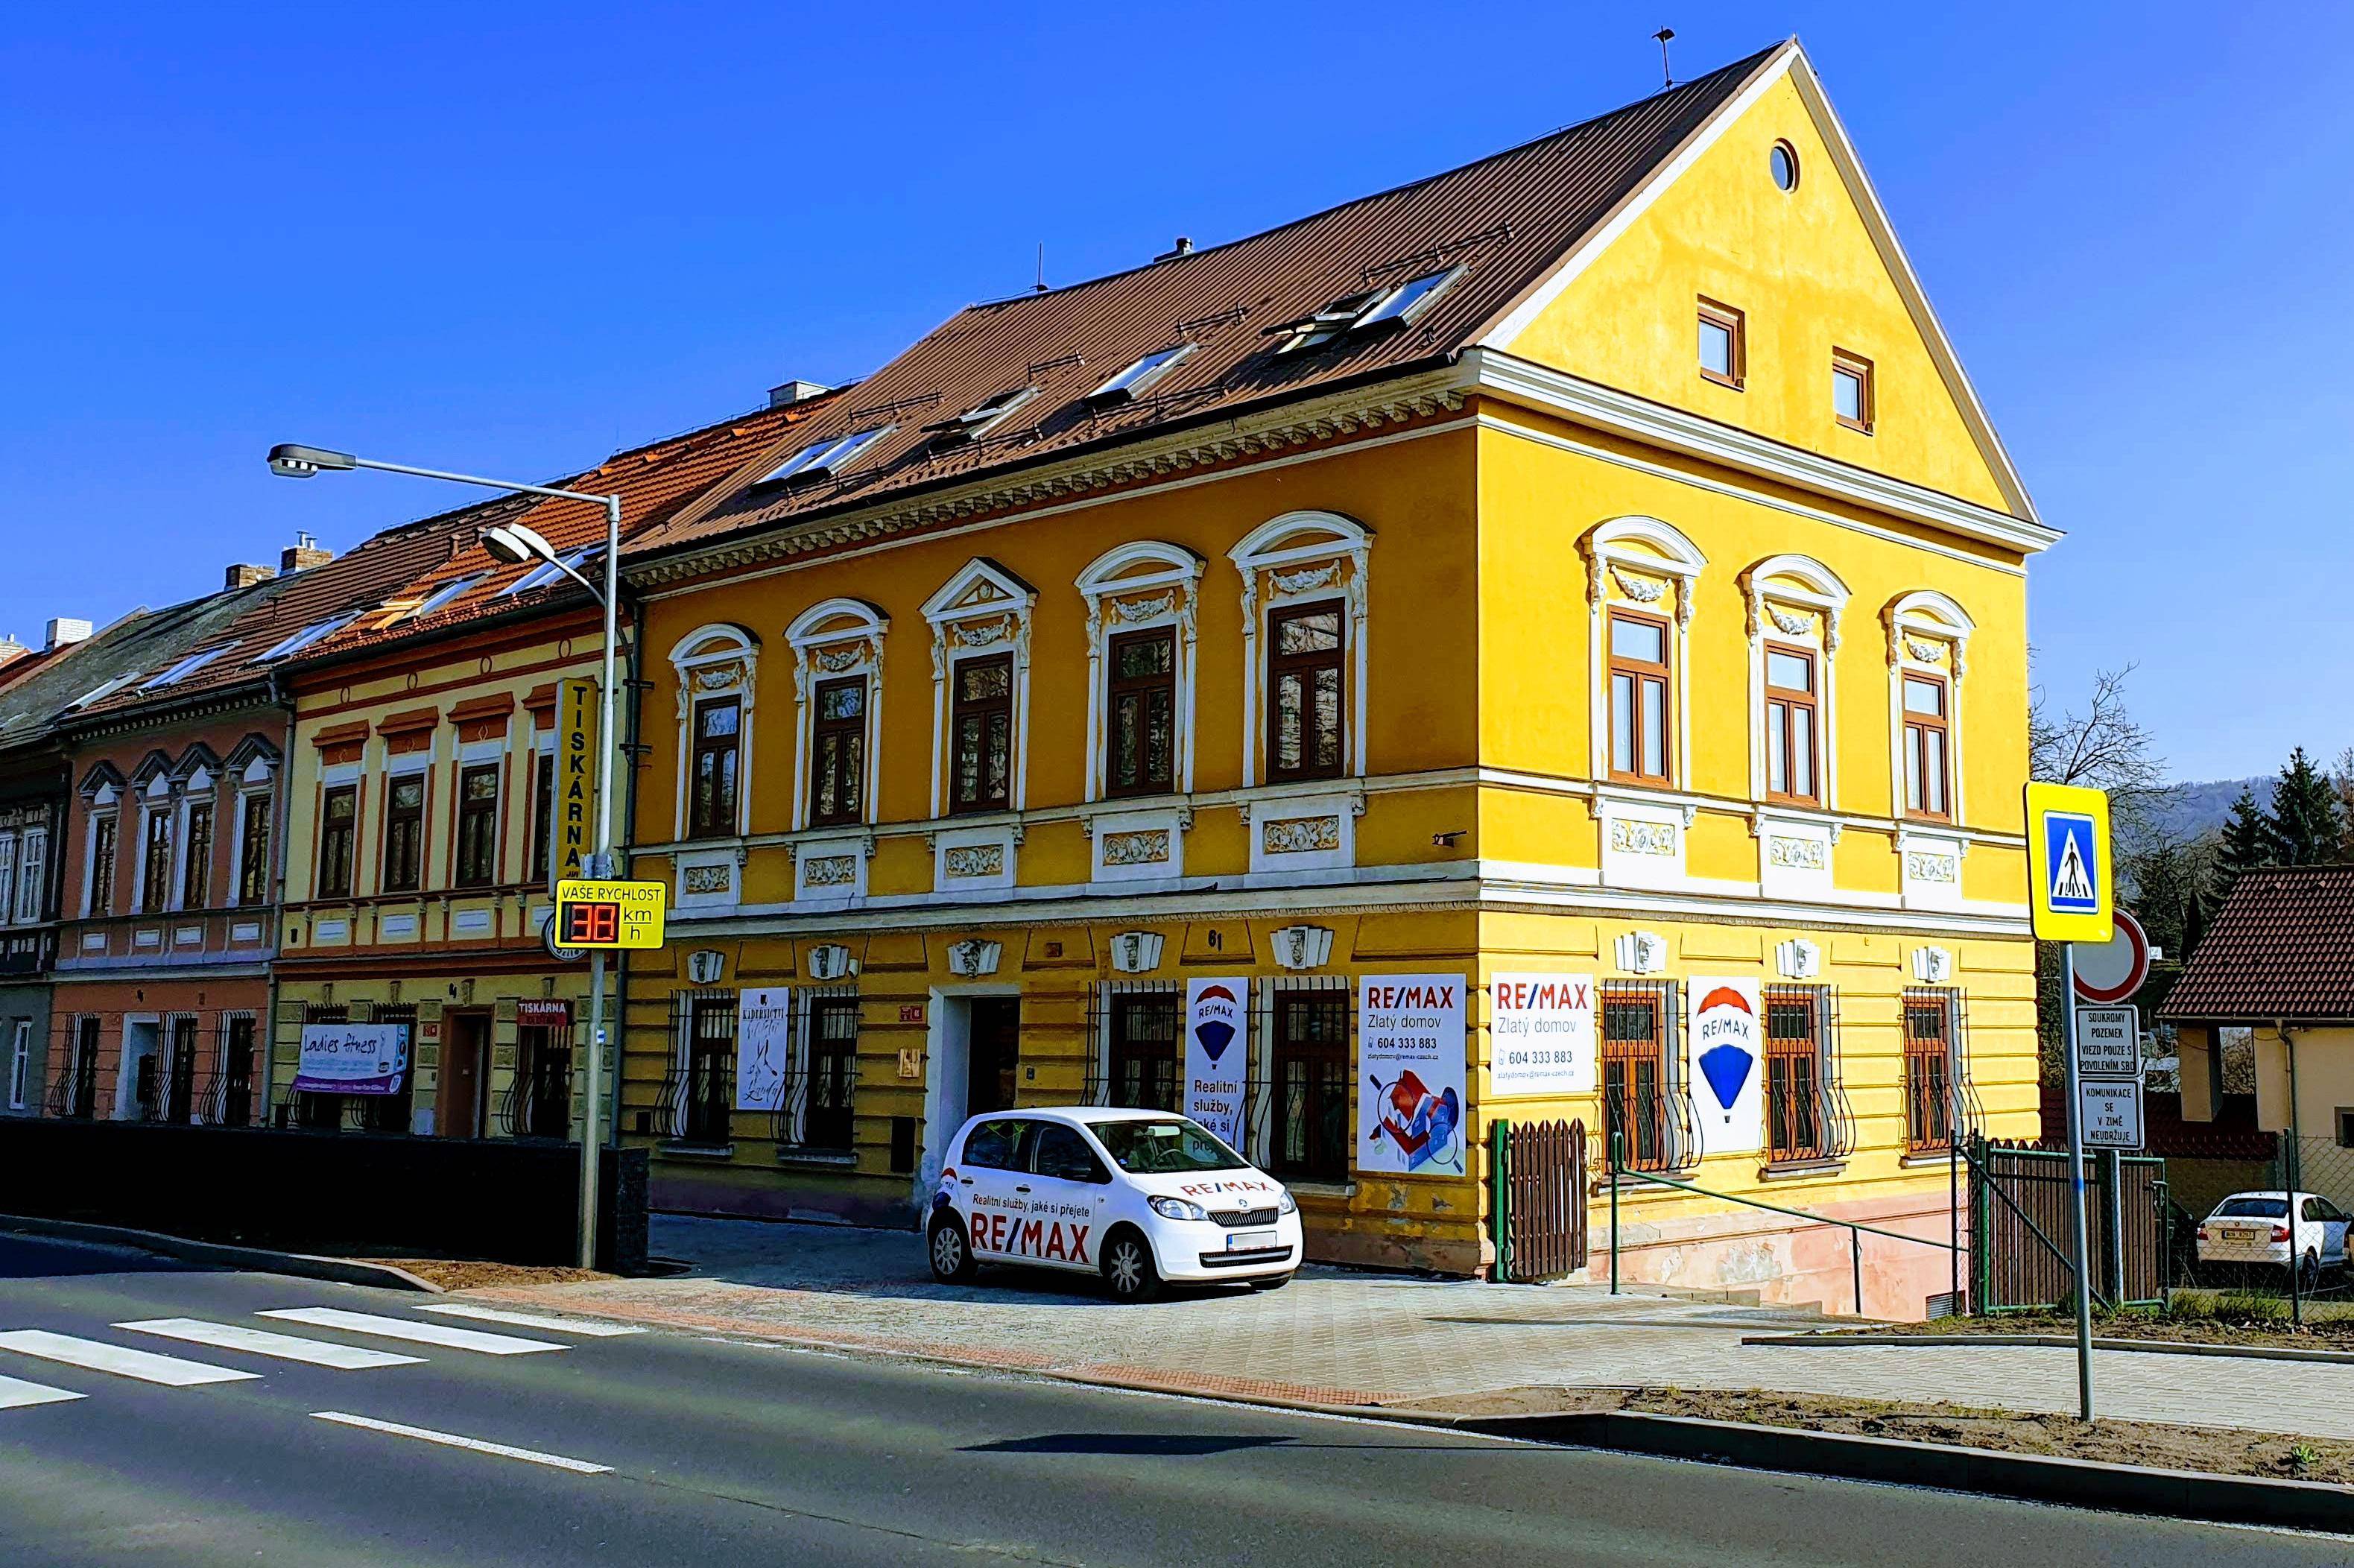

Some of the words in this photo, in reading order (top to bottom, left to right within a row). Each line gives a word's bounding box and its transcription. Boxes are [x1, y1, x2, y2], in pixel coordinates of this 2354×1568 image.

[565, 686, 587, 867] TISKÁRNA
[562, 885, 594, 899] VAŠE
[598, 887, 662, 901] RYCHLOST
[624, 906, 652, 922] km
[630, 925, 640, 941] h
[1208, 929, 1222, 952] 61
[1367, 986, 1453, 1008] RE/MAX
[1498, 983, 1587, 1009] RE/MAX
[518, 1001, 566, 1013] TISKÁRNA
[1198, 1005, 1233, 1019] RE/MAX
[1367, 1014, 1396, 1031] Zlatý
[1401, 1015, 1441, 1028] domov
[1498, 1017, 1529, 1037] Zlatý
[1535, 1017, 1576, 1033] domov
[1703, 1018, 1749, 1040] RE/MAX
[2091, 1028, 2123, 1038] POZEMEK
[304, 1034, 339, 1053] Ladies
[1377, 1037, 1395, 1049] 604
[1398, 1037, 1416, 1049] 333
[1419, 1037, 1437, 1049] 883
[2081, 1046, 2101, 1055] VJEZD
[2104, 1046, 2125, 1055] POUZE
[2127, 1046, 2132, 1055] S
[1509, 1052, 1528, 1063] 604
[1532, 1051, 1551, 1063] 333
[1554, 1051, 1572, 1063] 883
[2080, 1059, 2119, 1070] POVOLENÍM
[1194, 1080, 1237, 1093] Realitní
[2086, 1088, 2131, 1098] KOMUNIKACE
[1194, 1098, 1233, 1116] služby,
[2105, 1102, 2114, 1112] SE
[1220, 1119, 1230, 1132] si
[2098, 1116, 2102, 1126] V
[2106, 1115, 2123, 1127] ZIMĚ
[2090, 1129, 2130, 1142] NEUDRŽUJE
[972, 1194, 1001, 1207] Realitní
[1002, 1198, 1029, 1213] služby,
[1031, 1200, 1048, 1213] jaké
[1051, 1204, 1058, 1213] si
[1060, 1204, 1089, 1218] přejete
[970, 1213, 1089, 1263] RE/MAX
